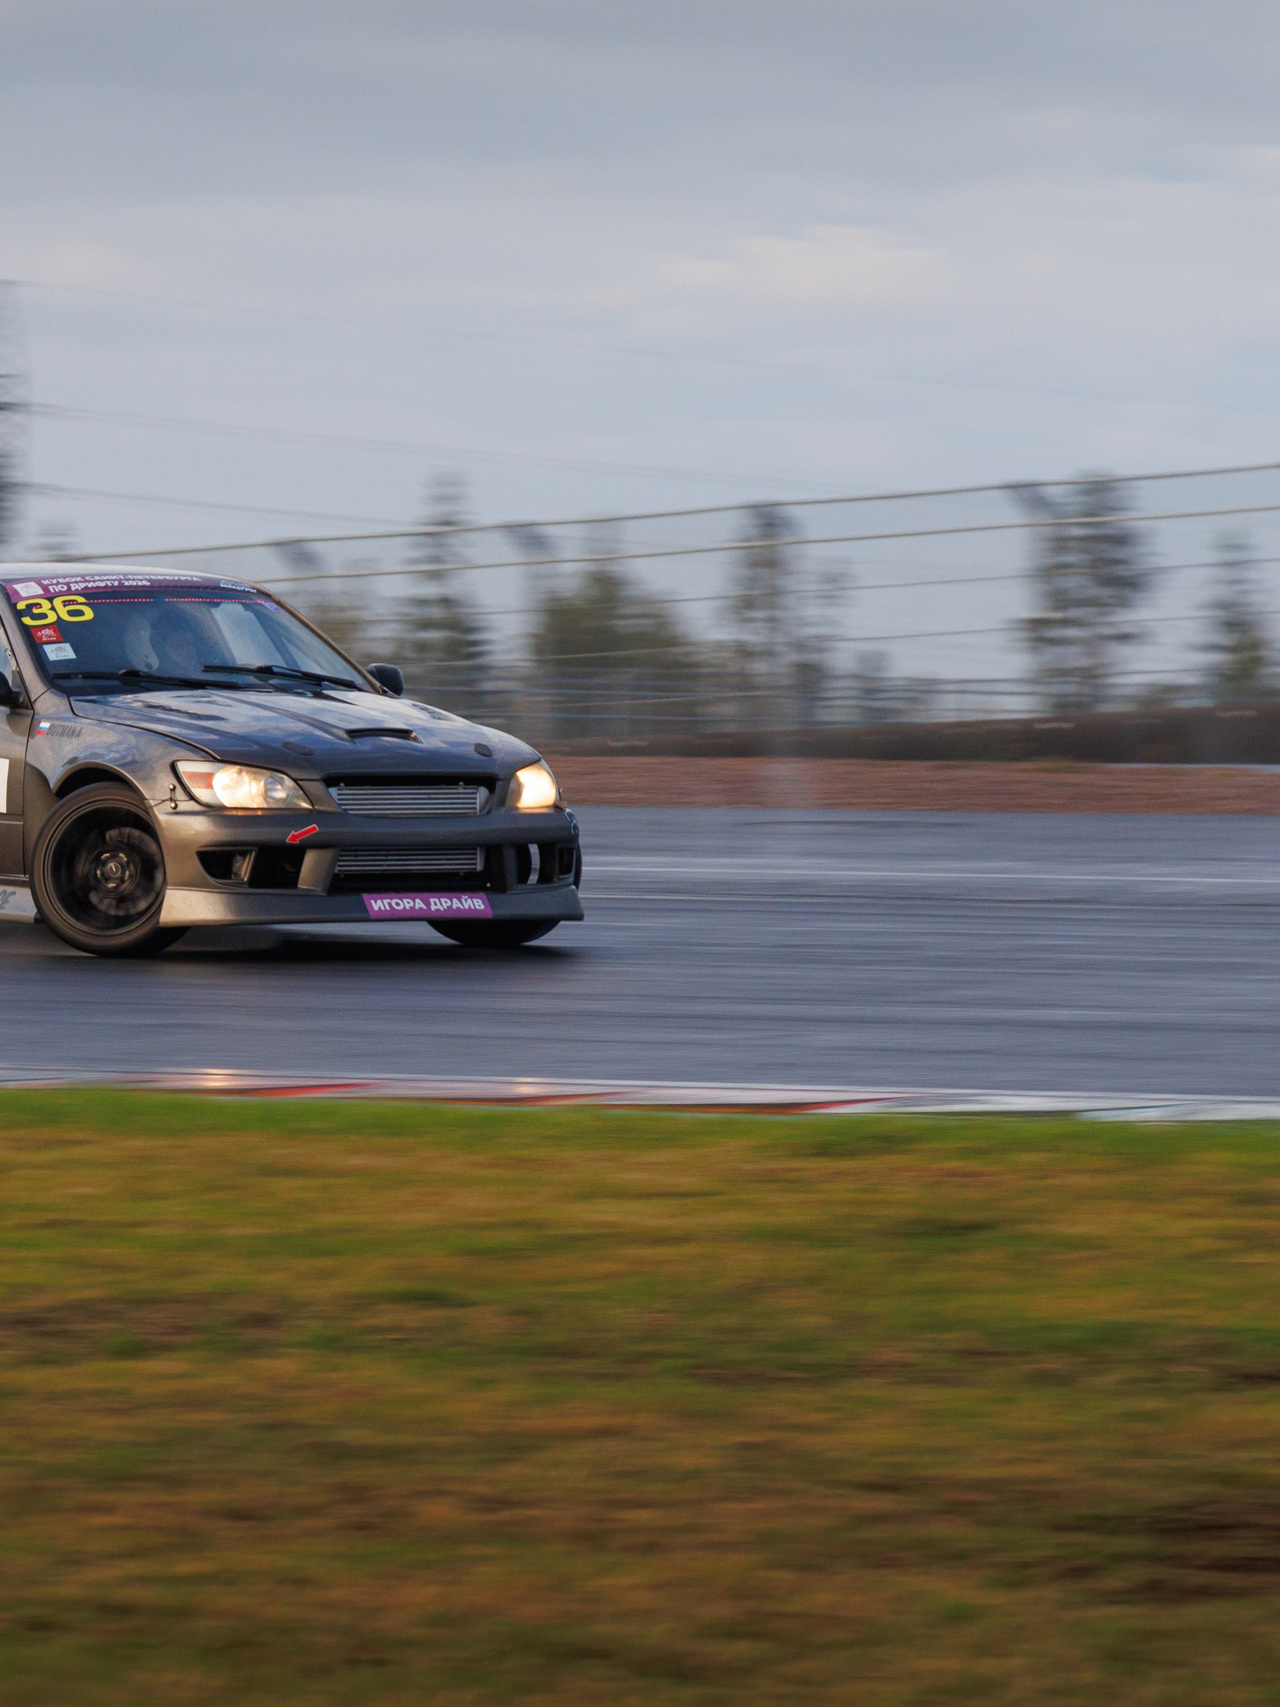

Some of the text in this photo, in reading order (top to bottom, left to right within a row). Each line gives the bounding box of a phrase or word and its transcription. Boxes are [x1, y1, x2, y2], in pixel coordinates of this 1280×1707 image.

[41, 576, 84, 585] КУБОК
[48, 585, 67, 593] ПО
[70, 580, 119, 592] ДРИФТУ
[16, 595, 94, 626] 36
[370, 895, 486, 912] ИГОРА ДРАЙВ
